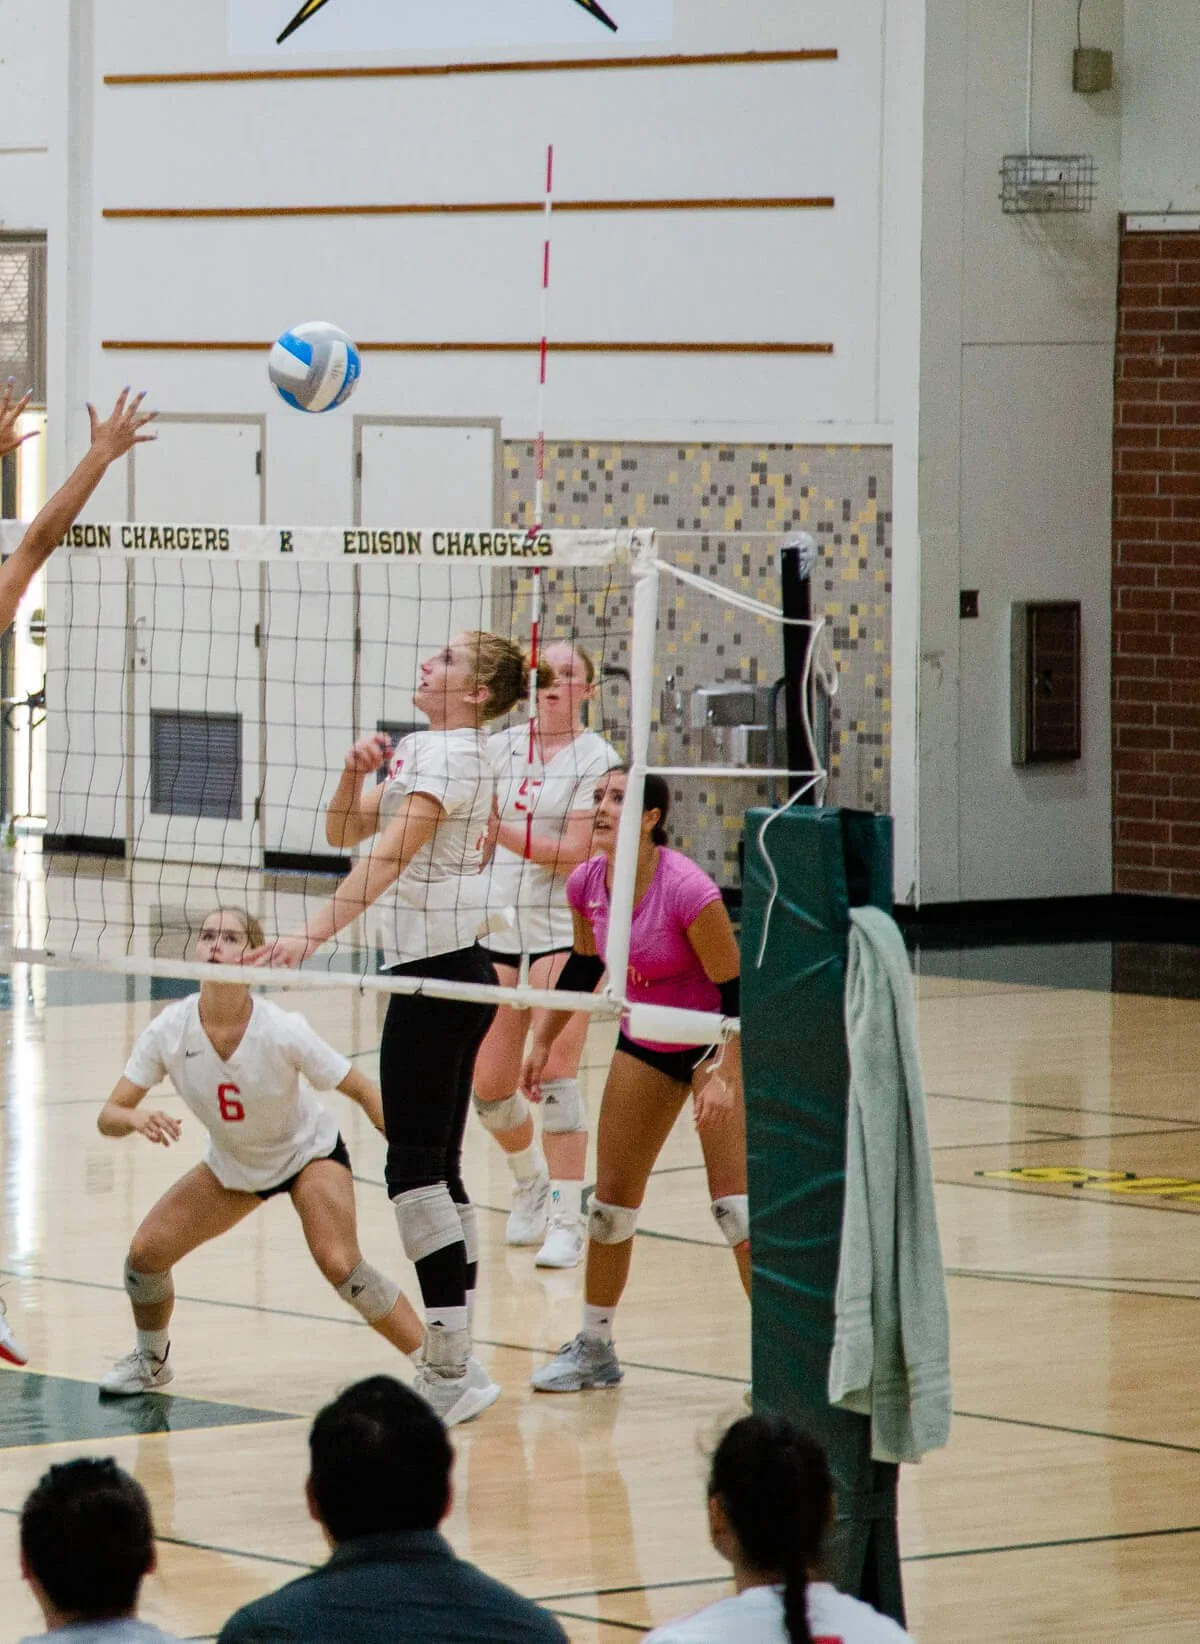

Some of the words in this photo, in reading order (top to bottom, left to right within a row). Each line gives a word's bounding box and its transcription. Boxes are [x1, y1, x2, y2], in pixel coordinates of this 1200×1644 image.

[58, 524, 111, 548] ISON
[121, 526, 230, 552] CHARGERS
[343, 531, 422, 555] EDISON
[432, 532, 553, 556] CHARGERS
[218, 1083, 245, 1122] 6
